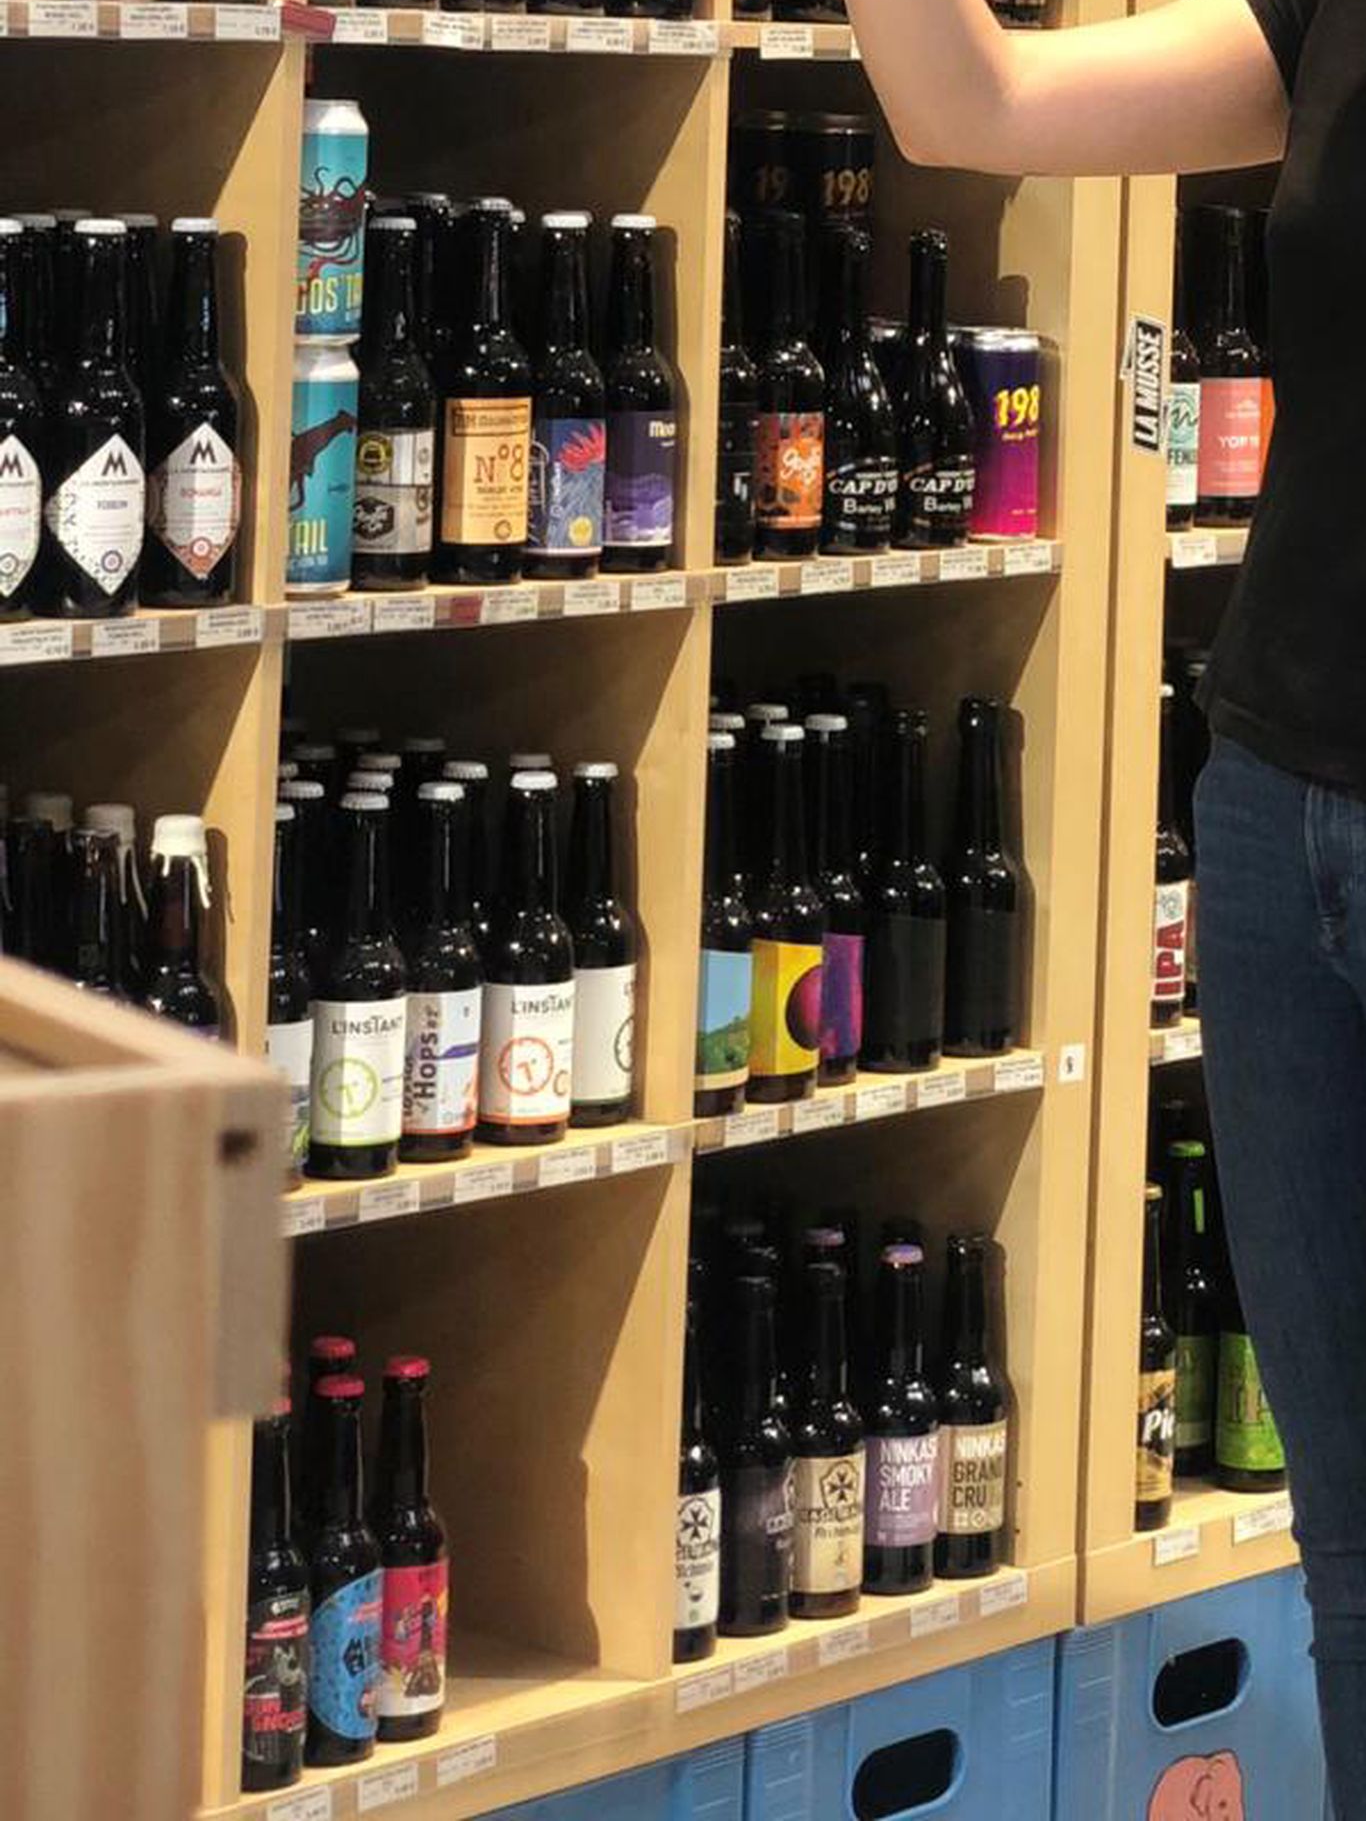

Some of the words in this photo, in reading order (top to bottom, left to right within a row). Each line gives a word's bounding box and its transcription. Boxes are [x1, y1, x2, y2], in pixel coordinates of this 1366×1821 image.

[1135, 325, 1164, 408] MUSSE
[1133, 410, 1161, 448] LA
[101, 451, 128, 477] M
[190, 440, 217, 465] M
[1, 453, 24, 478] M
[829, 478, 869, 495] CAP
[909, 477, 953, 493] CAP
[1155, 920, 1185, 996] IPA
[879, 1436, 939, 1464] NINKAS
[954, 1430, 1006, 1455] NINKAS
[952, 1459, 1001, 1483] GRAN
[879, 1489, 912, 1513] ALE
[951, 1485, 987, 1509] CRU
